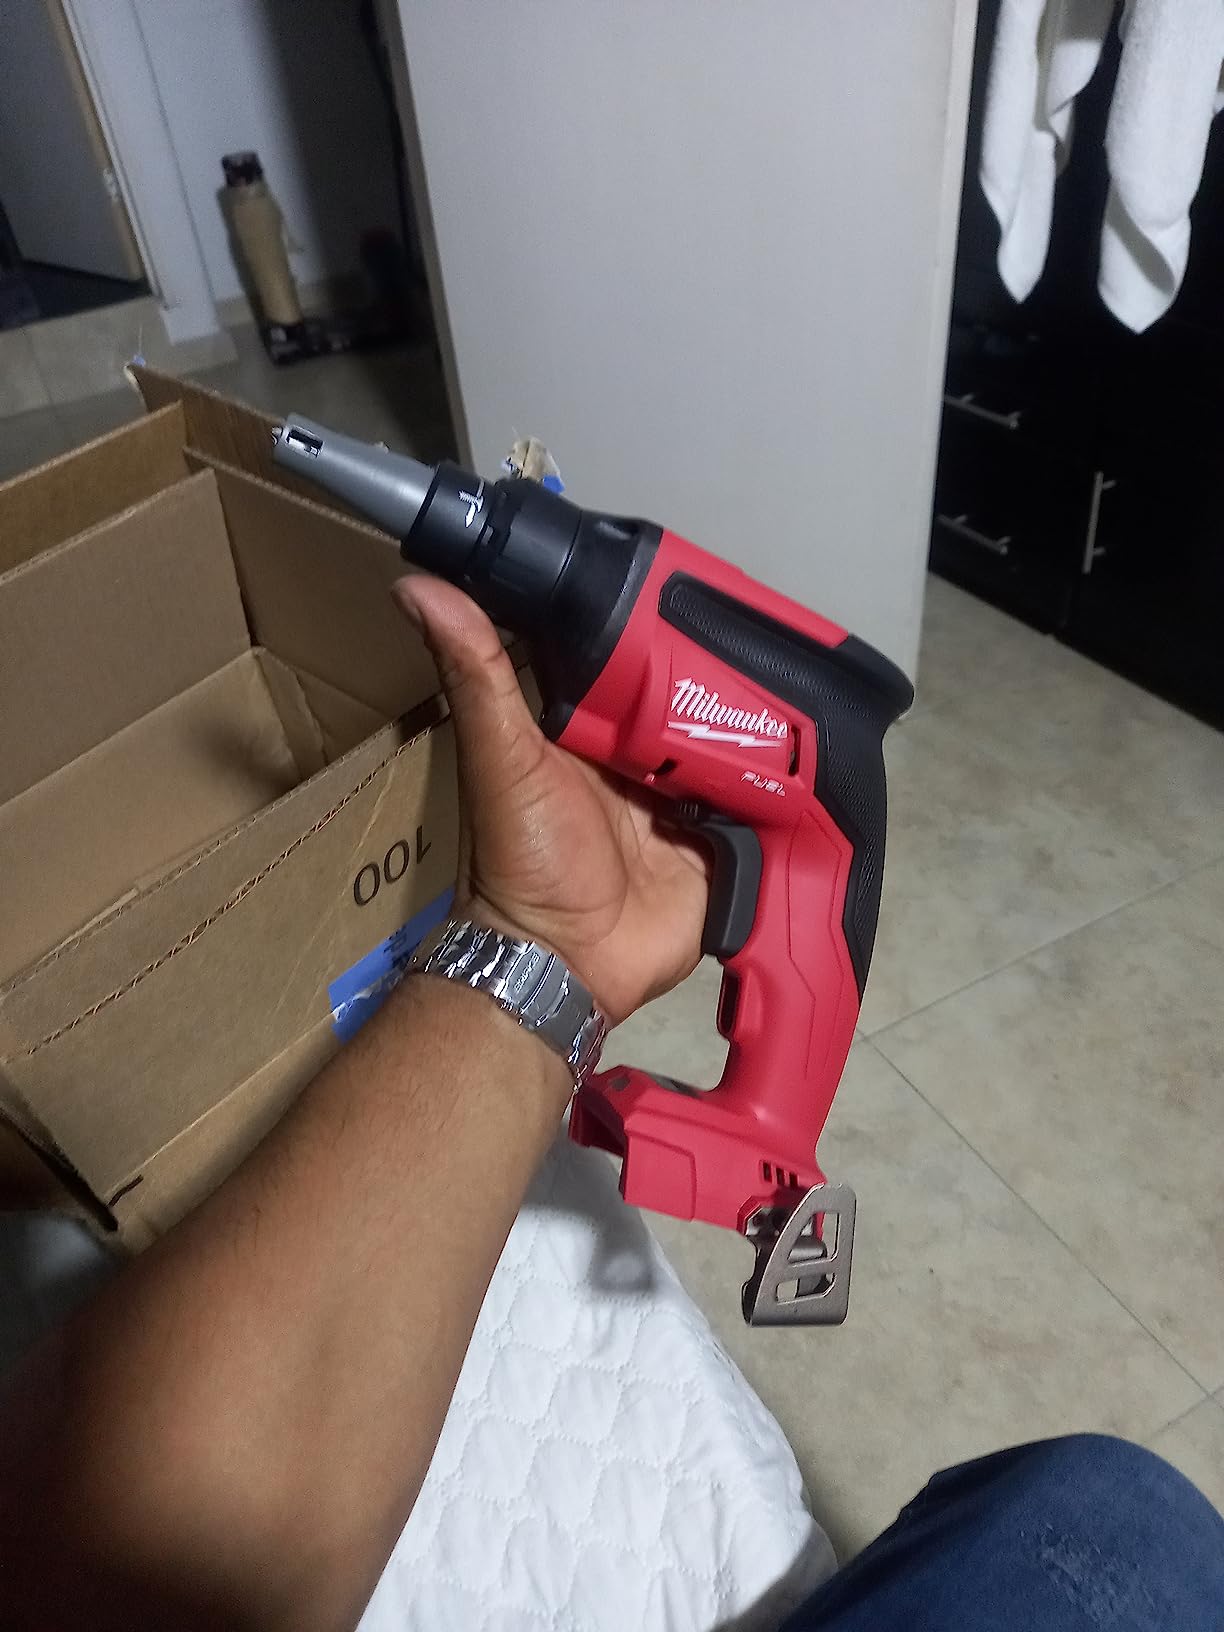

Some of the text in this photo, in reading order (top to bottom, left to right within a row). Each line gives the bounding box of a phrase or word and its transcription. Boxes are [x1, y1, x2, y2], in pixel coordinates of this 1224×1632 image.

[671, 678, 788, 738] Milwaukee
[740, 771, 786, 797] FUEL
[353, 825, 432, 906] 100
